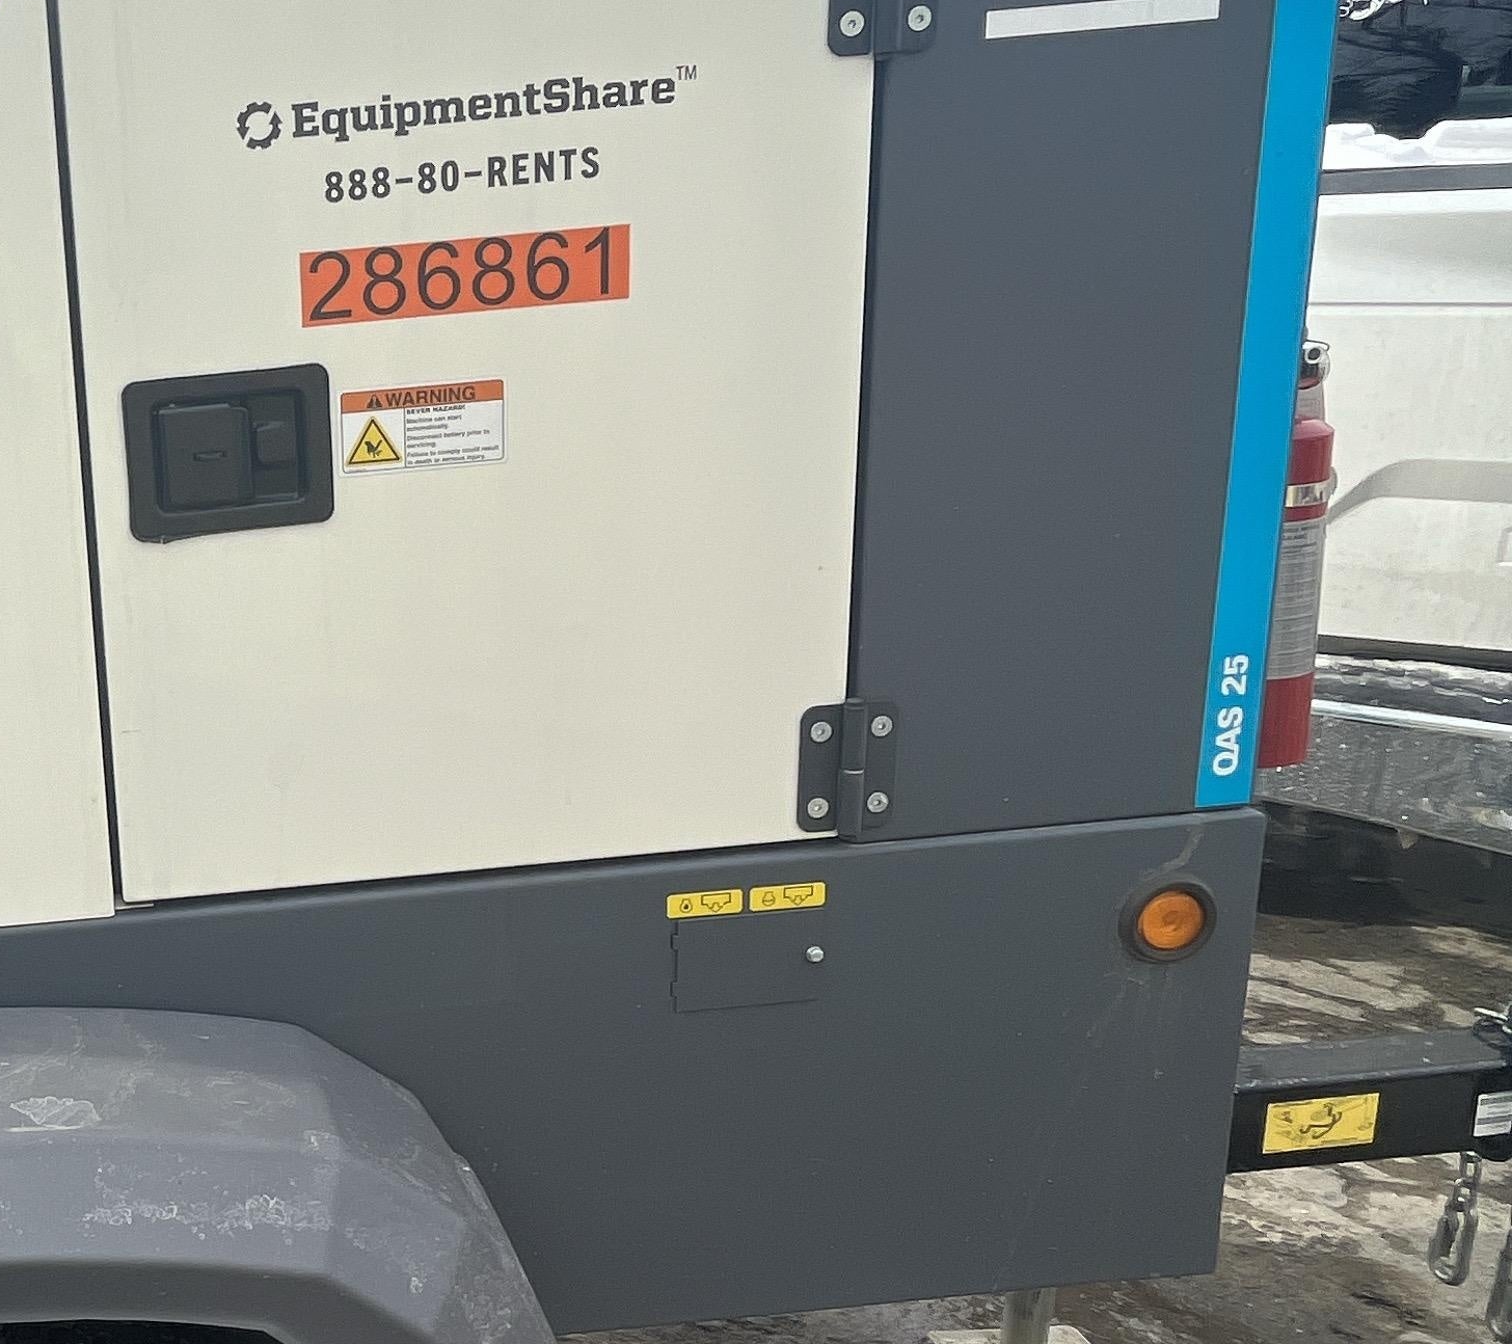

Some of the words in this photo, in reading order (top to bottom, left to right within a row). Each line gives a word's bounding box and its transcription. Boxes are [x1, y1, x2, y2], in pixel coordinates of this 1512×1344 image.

[324, 146, 600, 203] 888-80-RENTS
[308, 226, 611, 321] 286861
[385, 385, 476, 407] WARNING
[1220, 654, 1248, 696] 25
[1212, 706, 1244, 776] QAS
